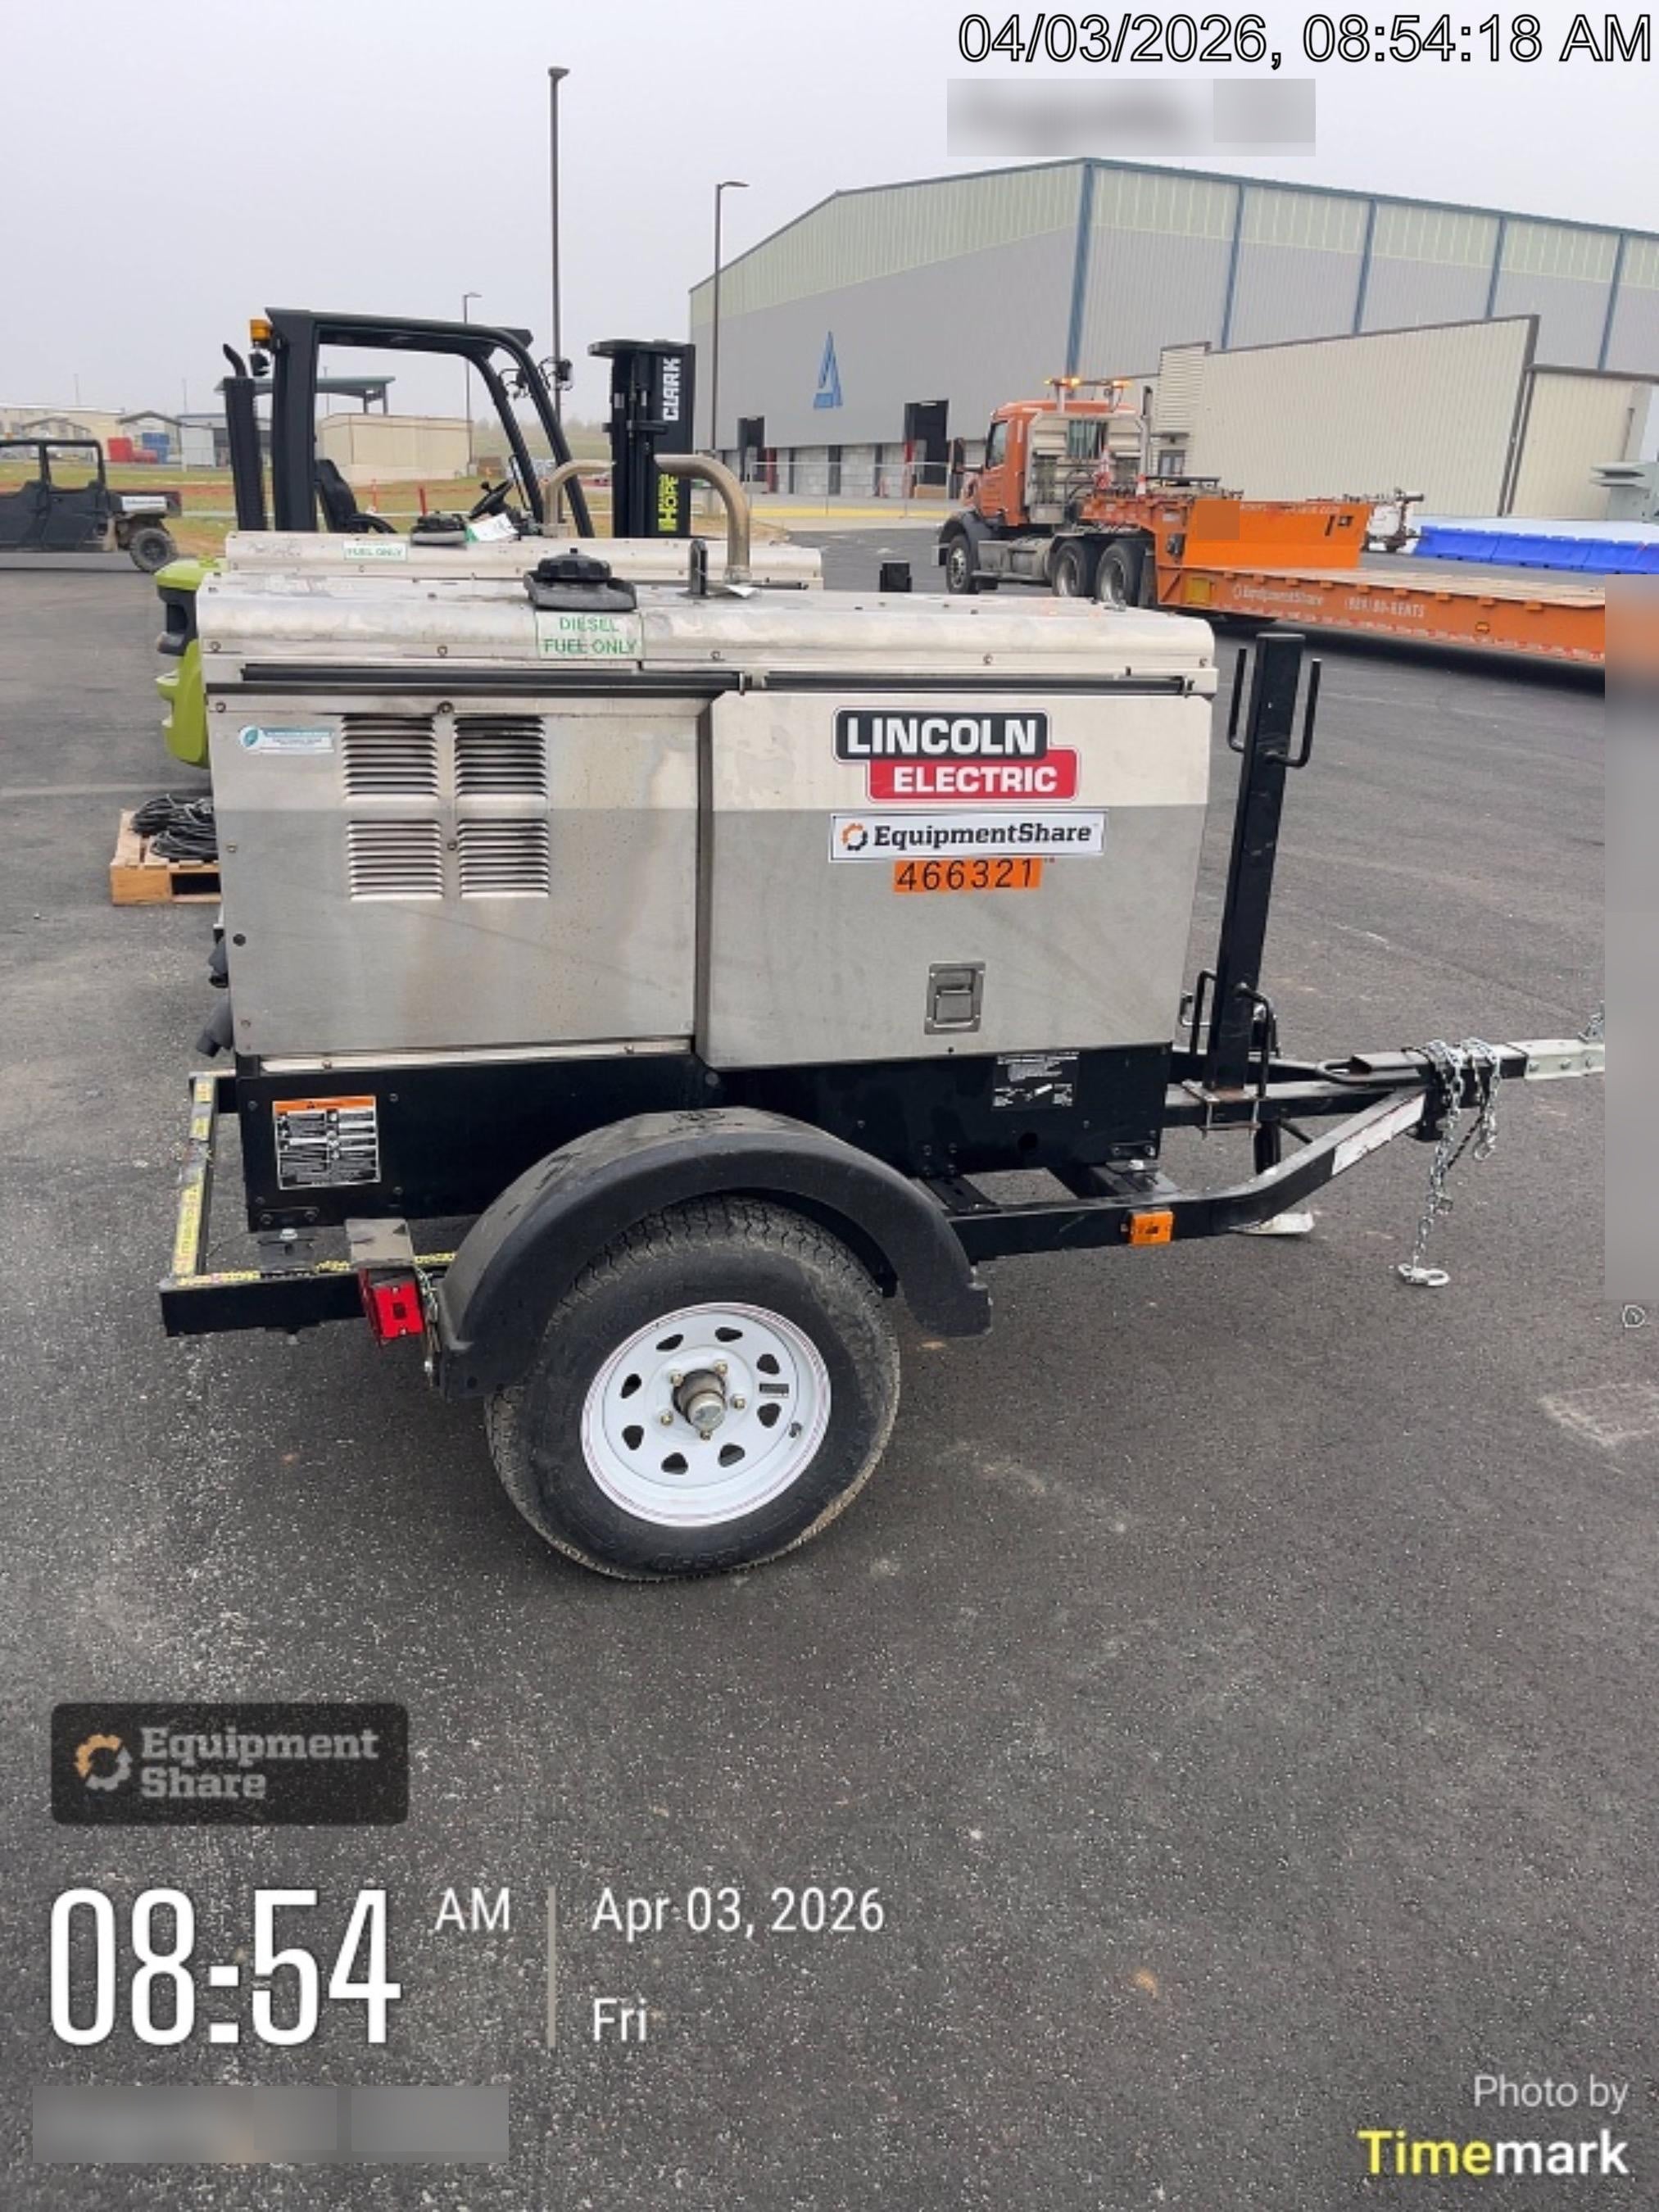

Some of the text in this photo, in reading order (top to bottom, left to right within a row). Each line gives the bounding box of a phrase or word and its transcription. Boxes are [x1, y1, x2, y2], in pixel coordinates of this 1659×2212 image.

[663, 357, 681, 421] CLARK
[559, 616, 619, 632] DIESEL
[543, 638, 637, 655] FUEL ONLY
[846, 717, 1038, 755] LINCOLN
[893, 765, 1058, 794] ELECTRIC
[873, 823, 1092, 850] EquipmentShare
[895, 858, 1034, 891] 466321
